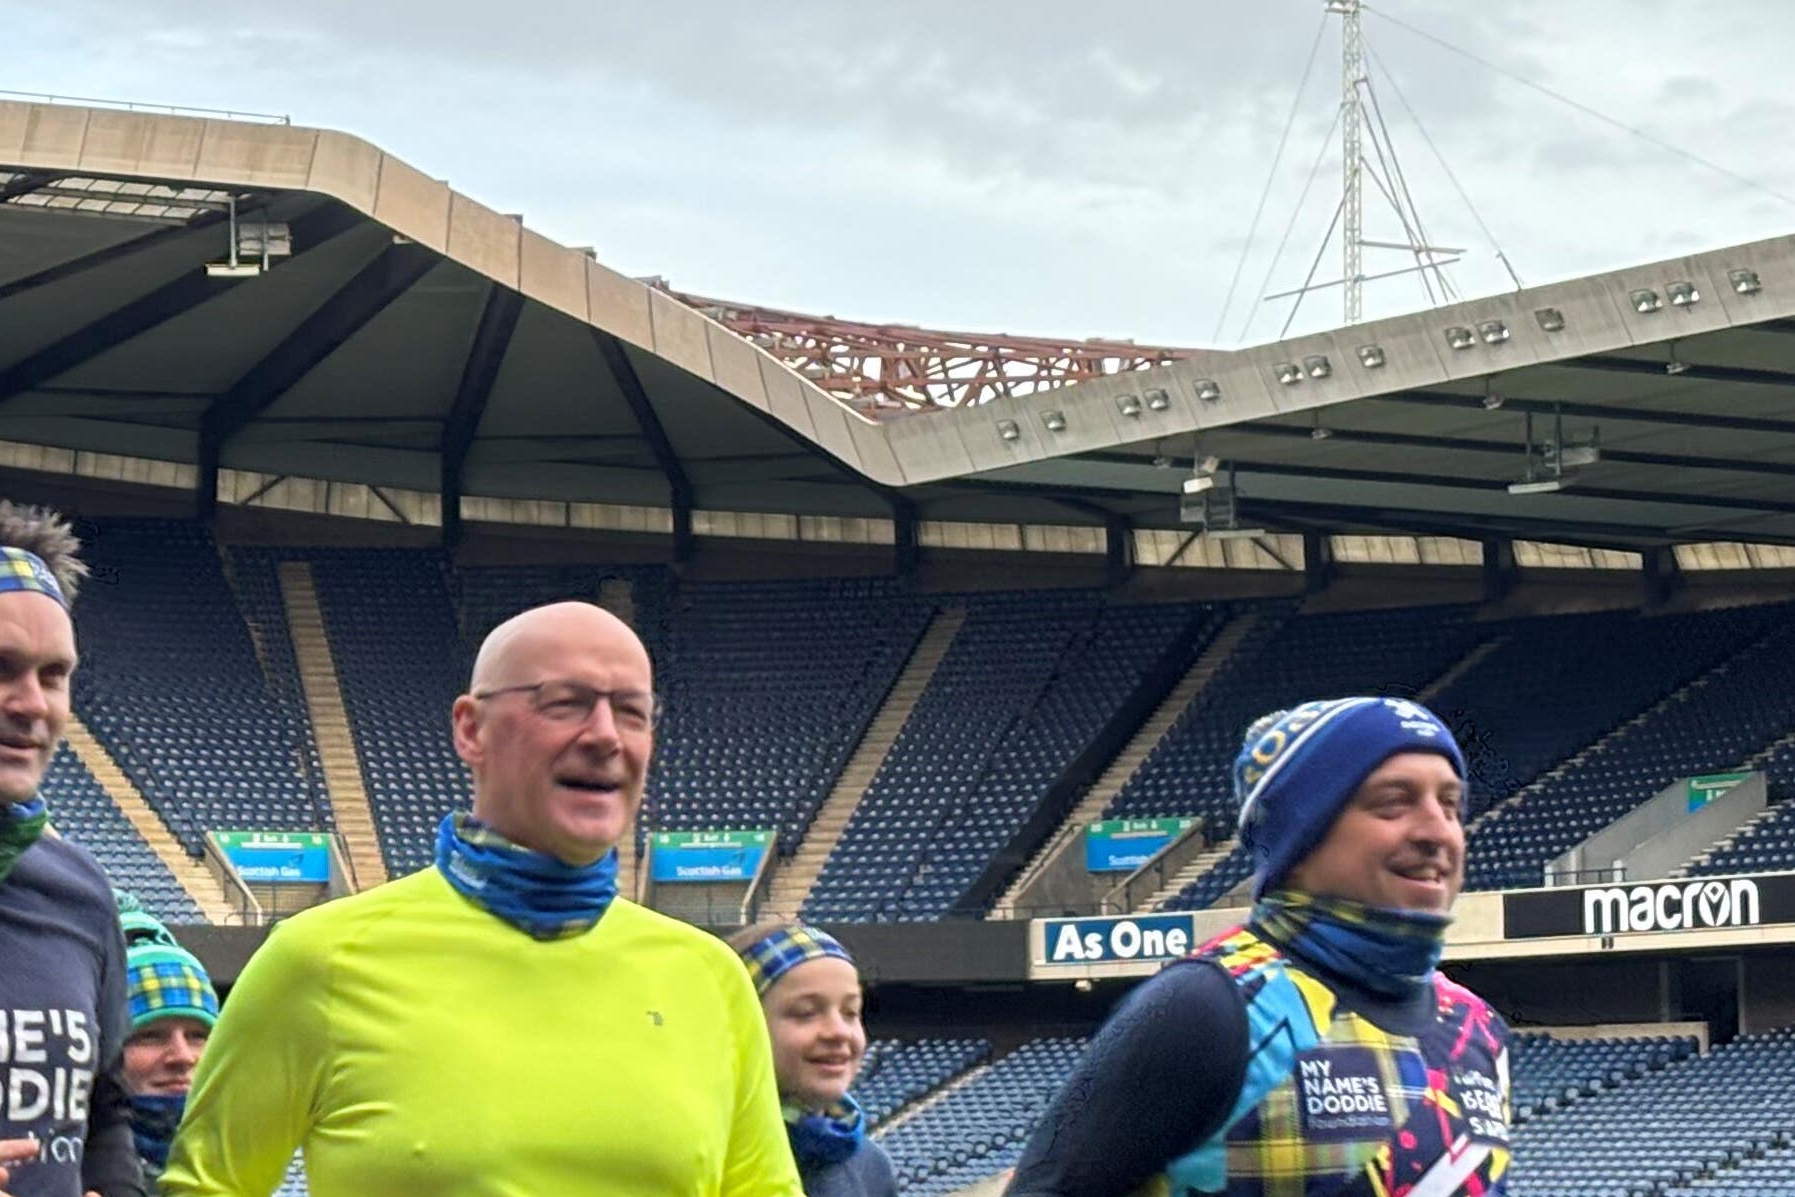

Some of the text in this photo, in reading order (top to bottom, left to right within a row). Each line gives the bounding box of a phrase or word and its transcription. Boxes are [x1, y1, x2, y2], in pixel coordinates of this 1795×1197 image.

[1584, 879, 1760, 934] macron
[1053, 921, 1188, 960] As One
[1300, 1060, 1331, 1078] MY
[1304, 1076, 1380, 1096] NAME'S
[1307, 1094, 1388, 1115] DODDIE
